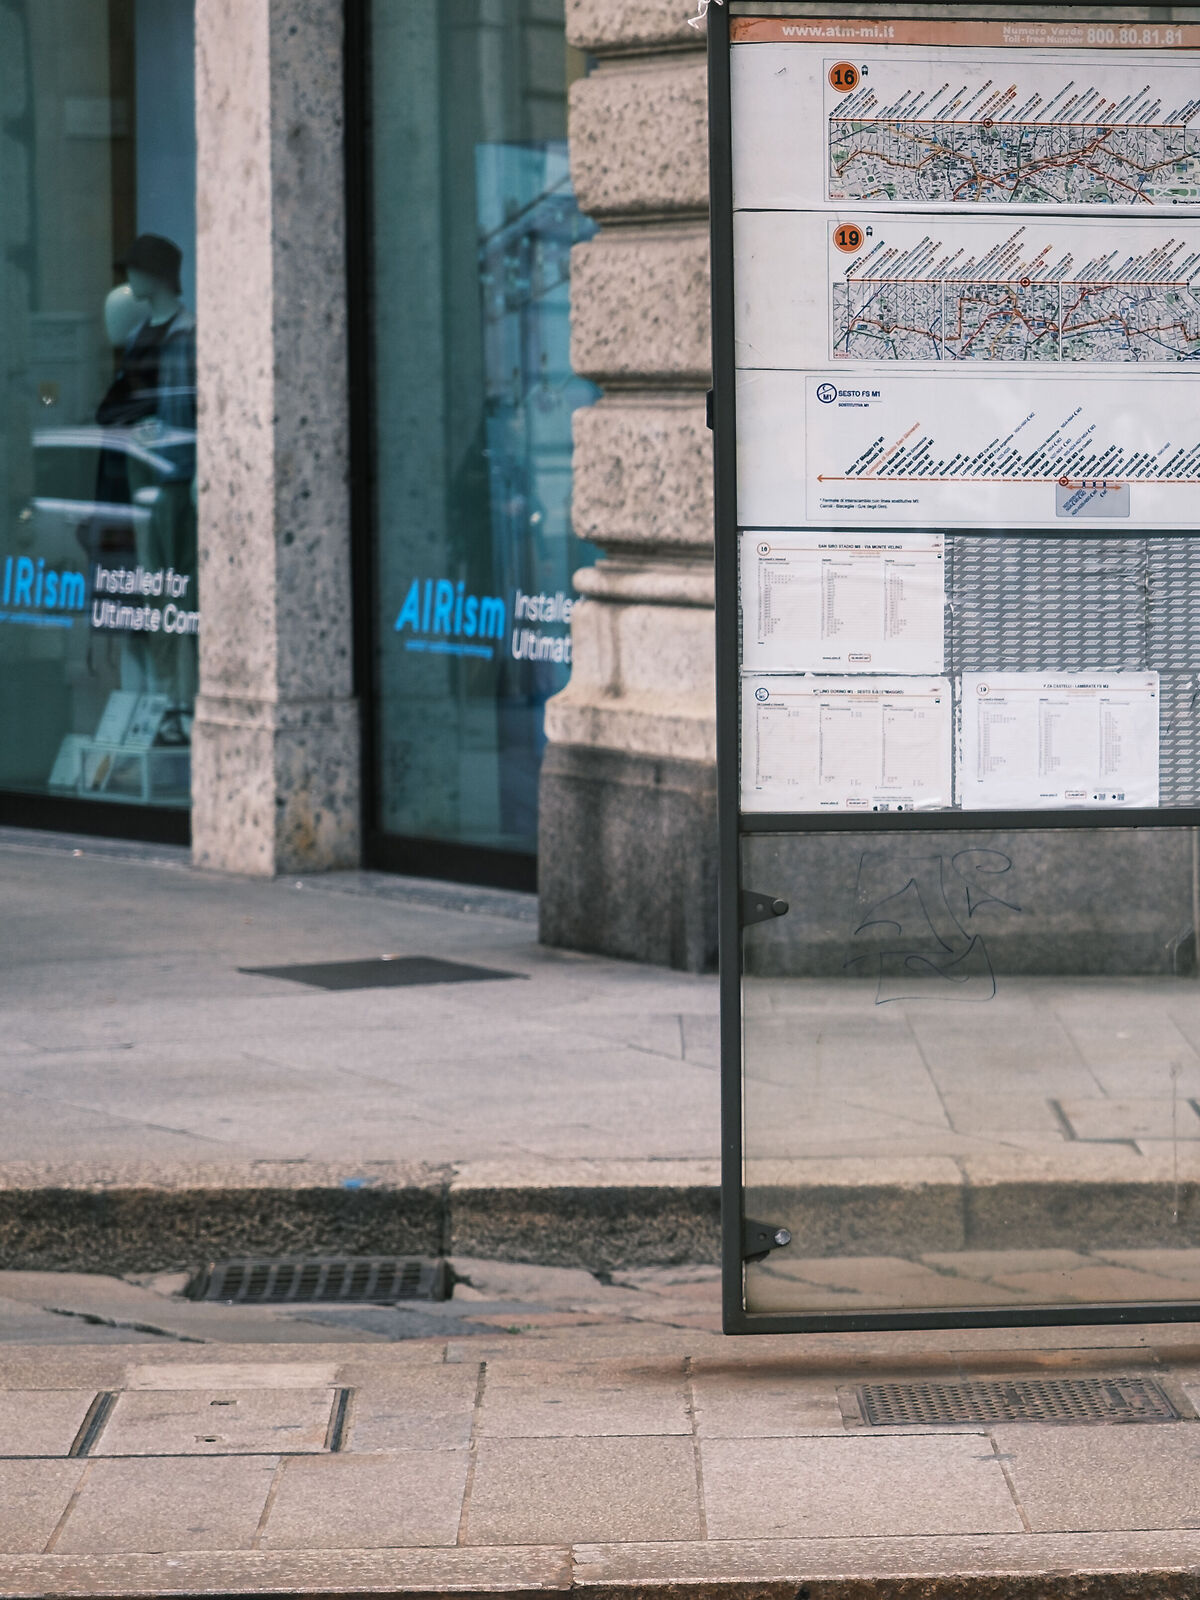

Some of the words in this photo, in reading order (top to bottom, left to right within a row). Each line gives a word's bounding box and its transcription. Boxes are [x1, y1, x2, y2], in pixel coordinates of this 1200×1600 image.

[782, 25, 894, 38] www.atm-mi.it
[1003, 26, 1047, 36] Numero
[1051, 27, 1084, 36] Verde
[1087, 28, 1183, 44] 800.80.81.81
[1047, 35, 1084, 44] Number
[834, 70, 855, 85] 16
[839, 231, 859, 245] 19
[96, 564, 164, 597] Installed
[166, 567, 190, 597] for
[395, 577, 506, 640] AIRism
[92, 601, 161, 632] Ultimate
